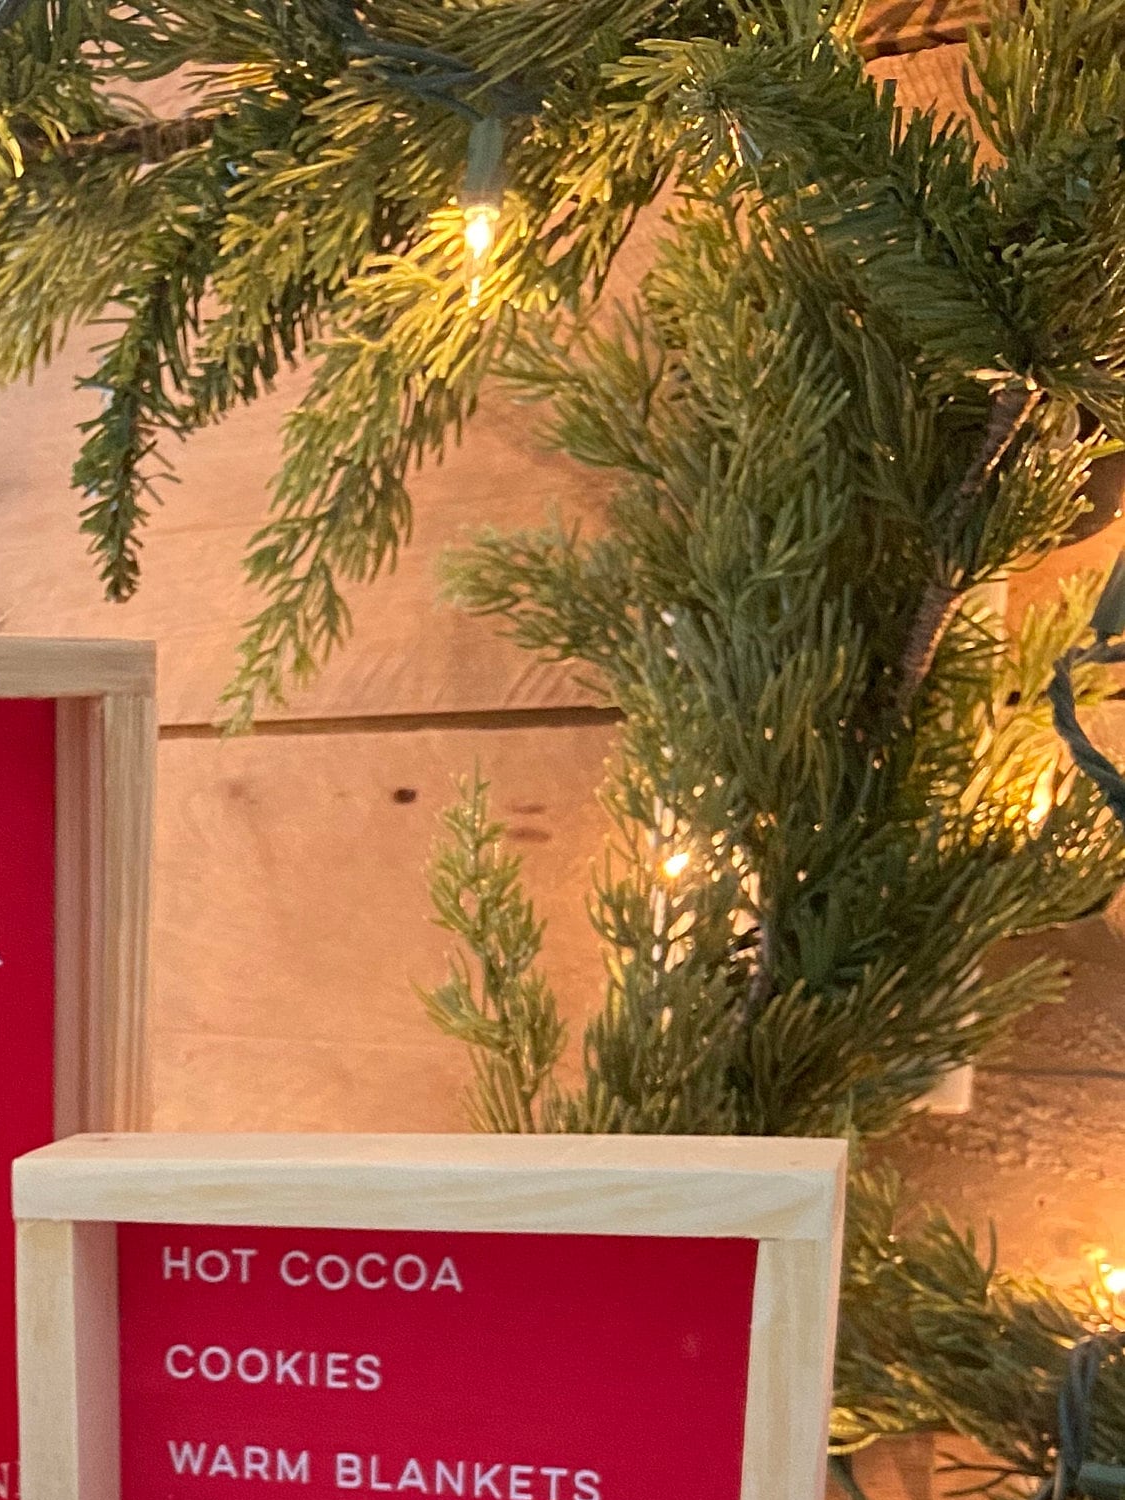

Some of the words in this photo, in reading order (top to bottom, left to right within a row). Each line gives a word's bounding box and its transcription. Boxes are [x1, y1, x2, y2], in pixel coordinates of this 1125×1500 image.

[162, 1245, 258, 1284] HOT
[279, 1249, 464, 1294] COCOA
[164, 1343, 382, 1392] COOKIES
[167, 1439, 311, 1485] WARM
